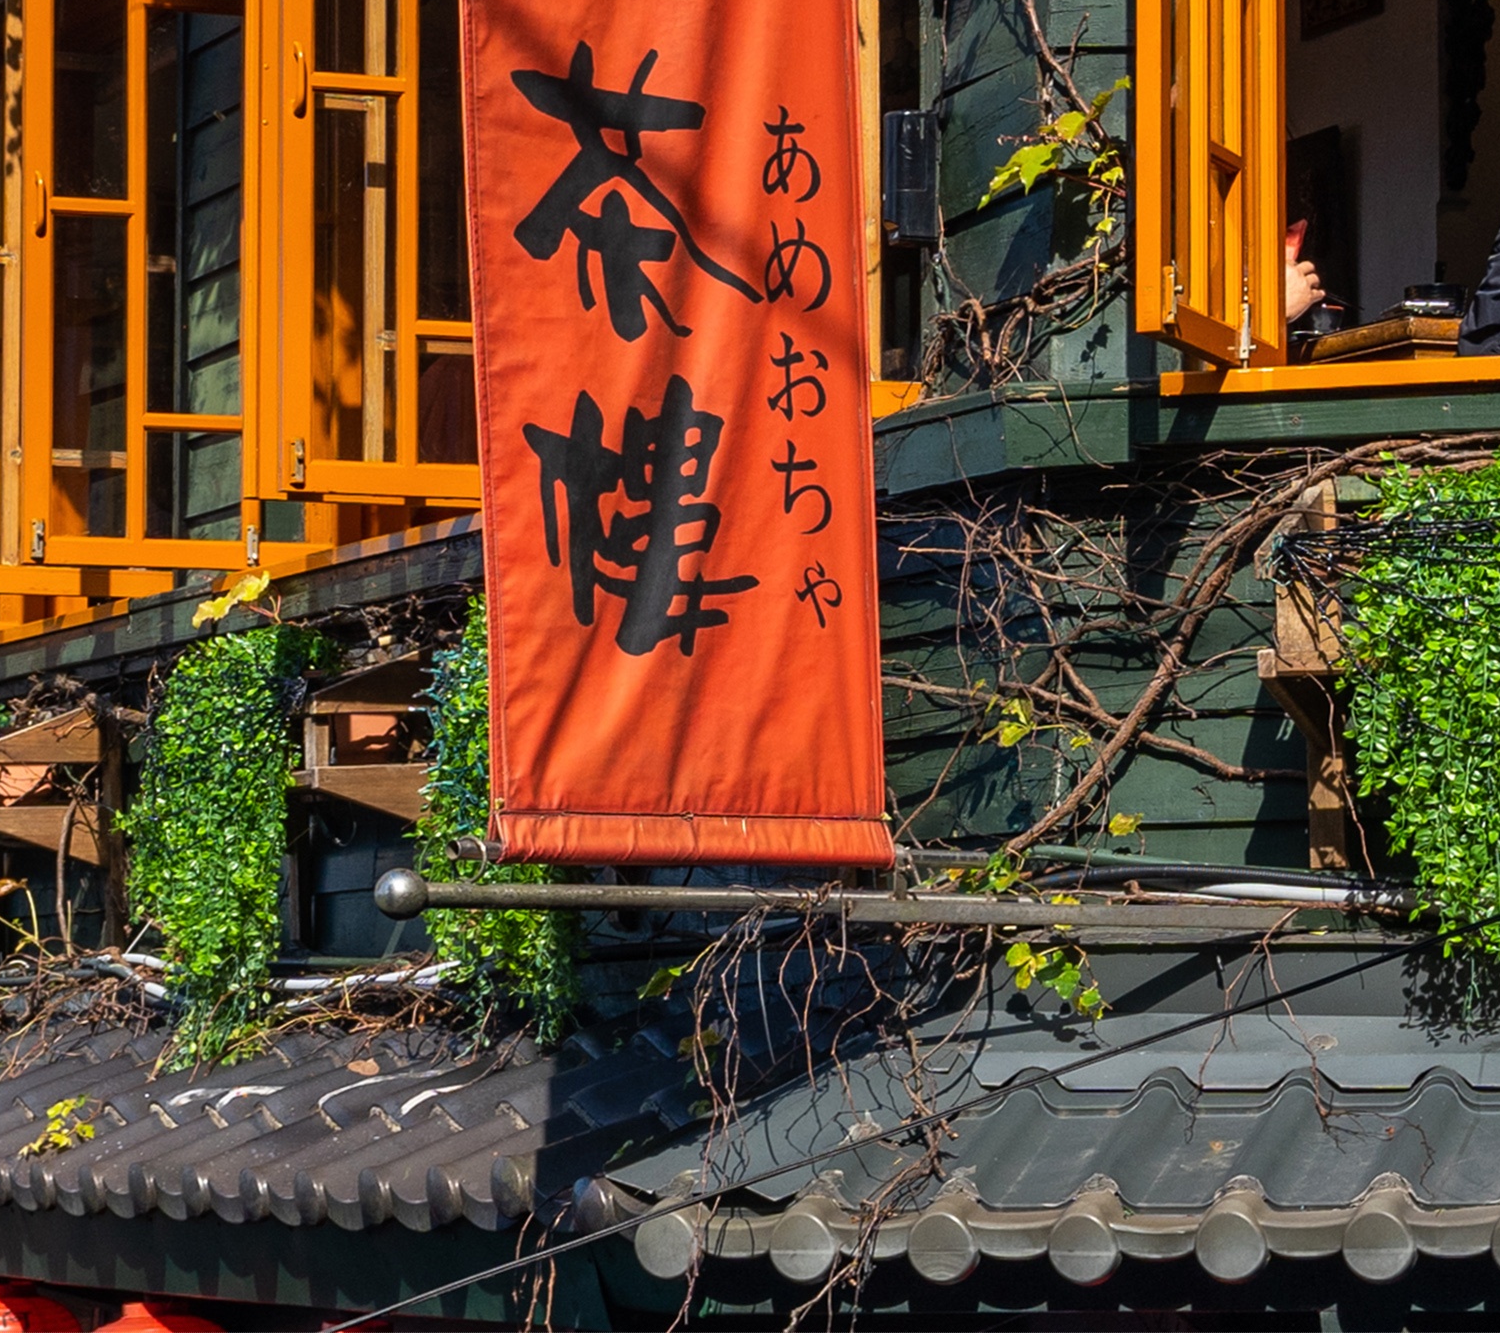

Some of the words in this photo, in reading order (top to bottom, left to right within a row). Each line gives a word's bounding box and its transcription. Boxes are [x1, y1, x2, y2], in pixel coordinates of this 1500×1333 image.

[761, 104, 843, 629] あめおちゃ
